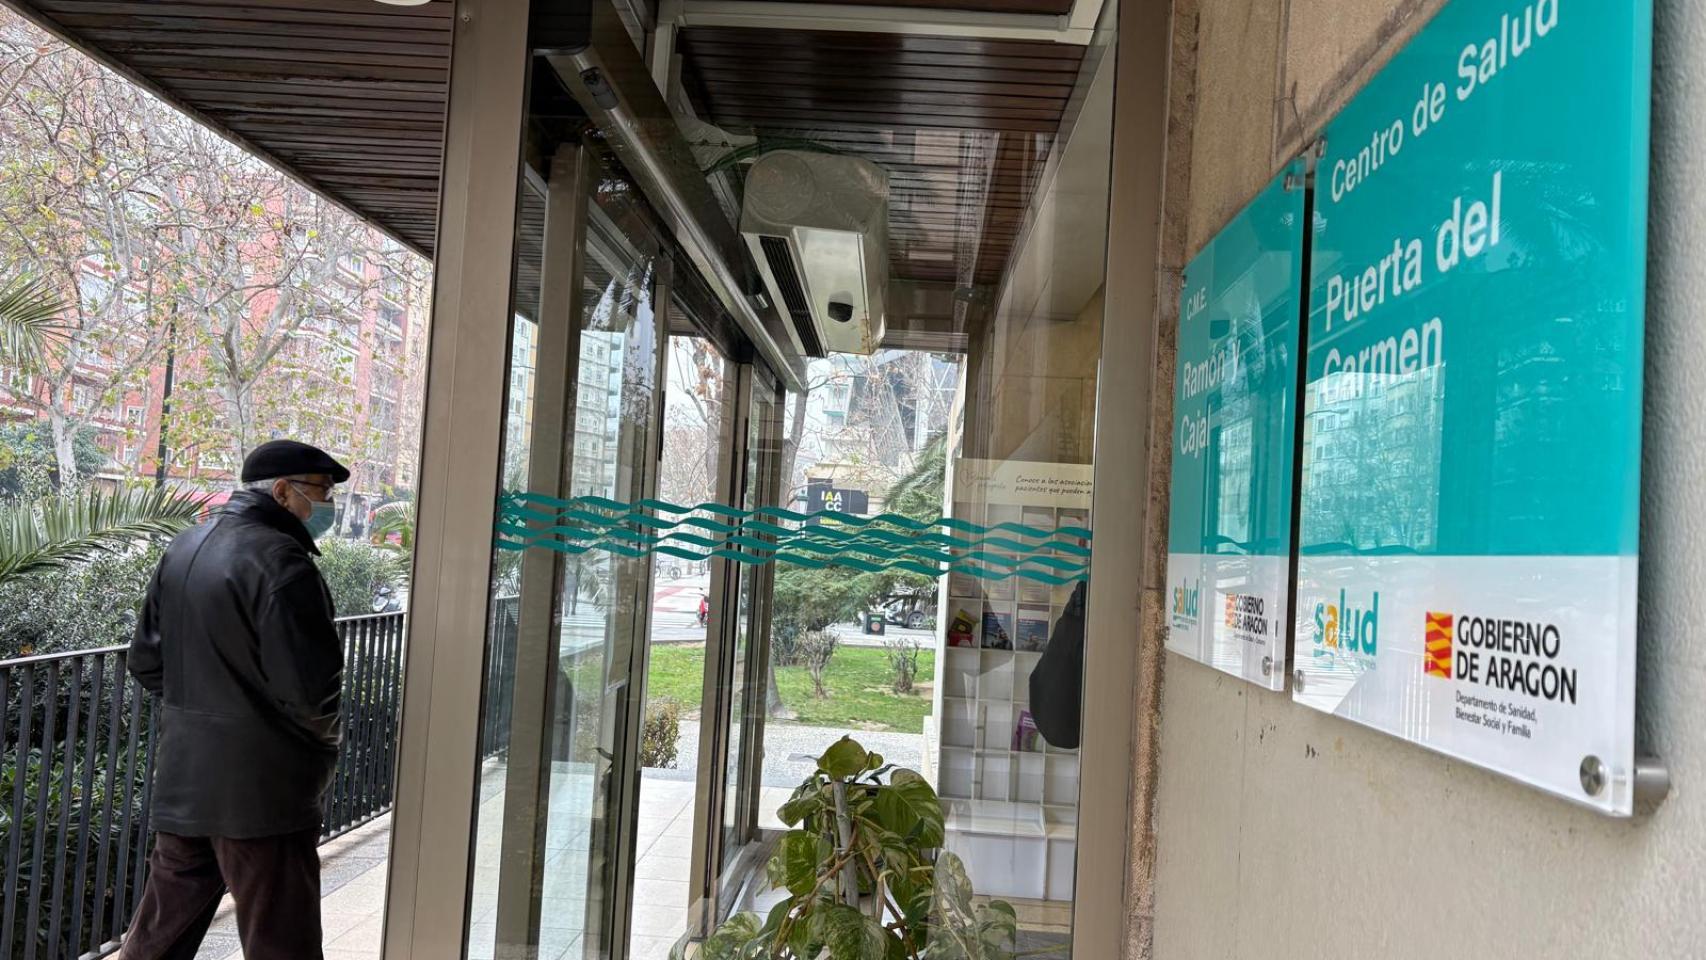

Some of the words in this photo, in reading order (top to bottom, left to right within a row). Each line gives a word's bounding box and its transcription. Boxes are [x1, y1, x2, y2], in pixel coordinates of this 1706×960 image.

[1331, 119, 1404, 203] Centro
[1412, 82, 1446, 137] de
[1456, 0, 1559, 101] Salud
[1325, 238, 1422, 332] Puerta
[1436, 170, 1502, 273] del
[1182, 342, 1226, 400] Ramón
[1231, 339, 1241, 385] y
[1179, 403, 1211, 459] Cajal
[821, 490, 843, 501] IAA
[825, 501, 842, 512] CC
[1173, 576, 1199, 617] salud
[1235, 594, 1264, 616] GOBIERNO
[1313, 587, 1379, 657] salud
[1457, 615, 1560, 659] GOBIERNO
[1456, 650, 1479, 684] DE
[1485, 655, 1577, 705] ARAGON
[1455, 707, 1482, 724] Bienestar
[1483, 714, 1501, 731] Social
[1507, 721, 1532, 739] Familia
[1456, 690, 1498, 713] Departamento
[1498, 703, 1507, 715] de
[1508, 703, 1537, 723] Sanidad,
